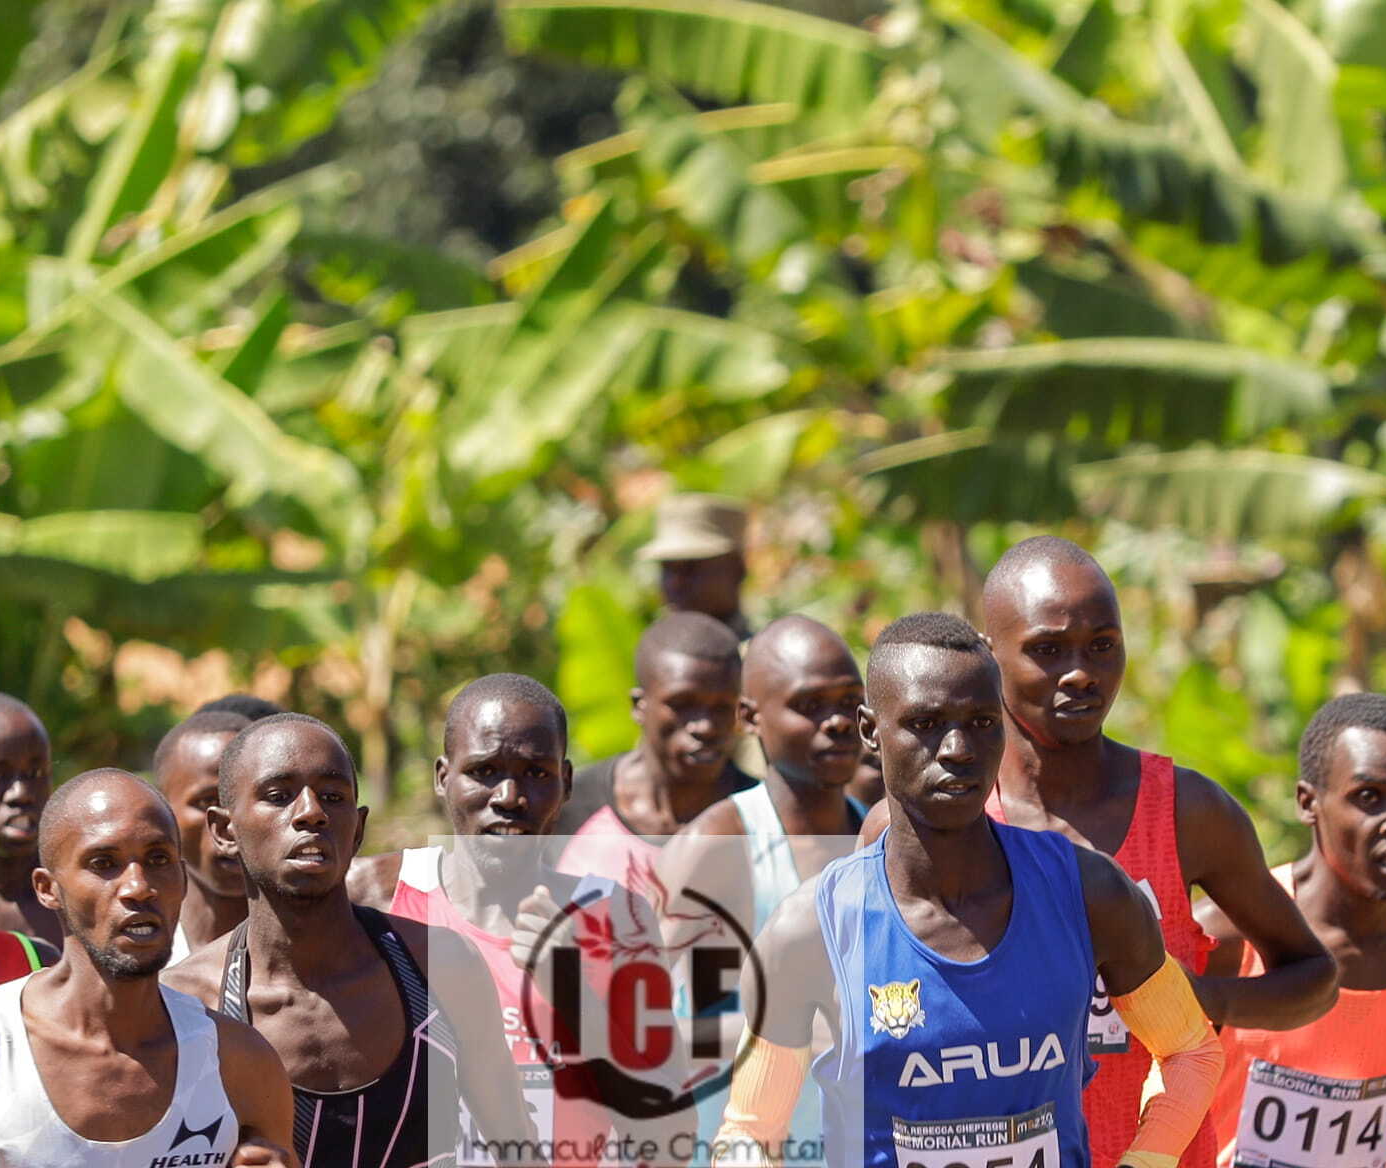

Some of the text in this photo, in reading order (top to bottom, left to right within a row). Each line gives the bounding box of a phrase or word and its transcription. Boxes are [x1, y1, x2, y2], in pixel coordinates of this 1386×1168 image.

[898, 1033, 1066, 1087] ARUA
[1330, 1087, 1362, 1100] RUN
[911, 1125, 955, 1135] REBECCA
[956, 1121, 1007, 1133] CHEPTEGEI
[1253, 1096, 1383, 1156] 0114
[894, 1131, 1008, 1150] MEMORIAL RUN
[149, 1152, 226, 1168] HEALTH
